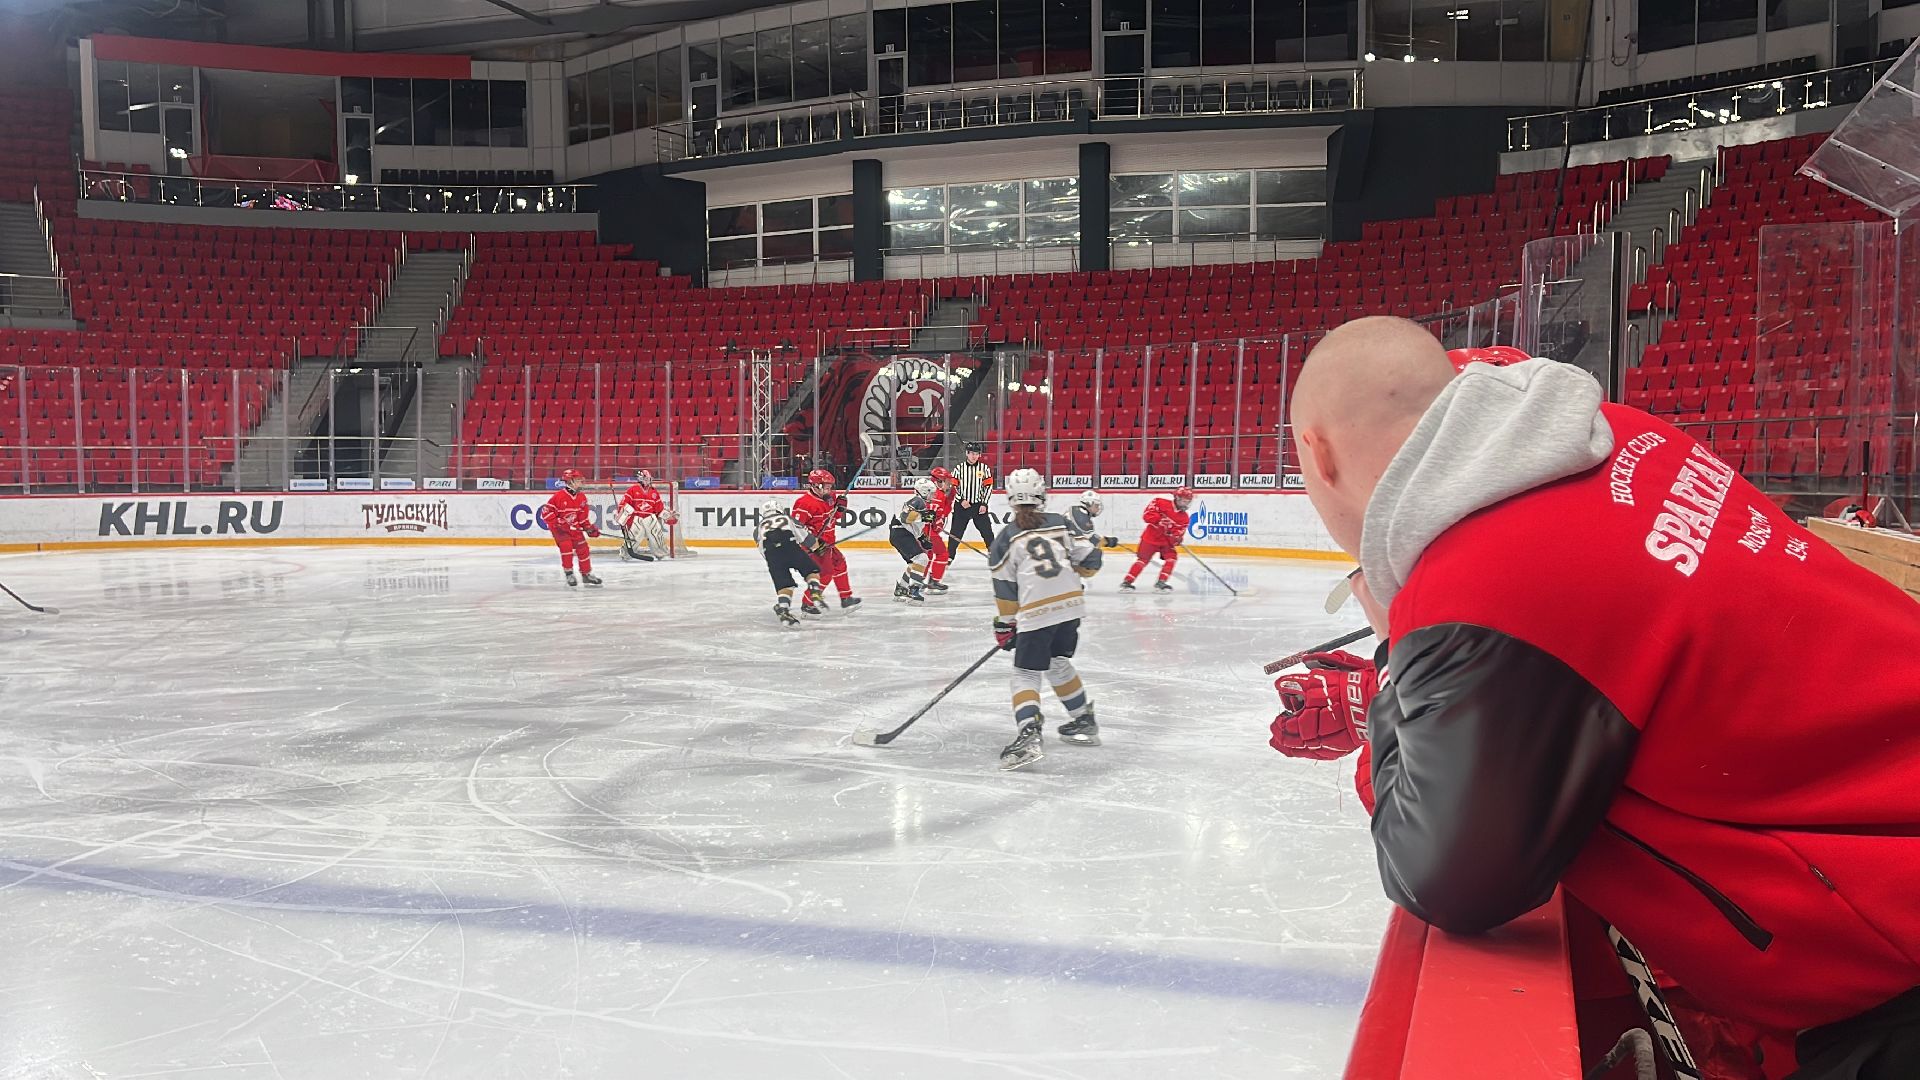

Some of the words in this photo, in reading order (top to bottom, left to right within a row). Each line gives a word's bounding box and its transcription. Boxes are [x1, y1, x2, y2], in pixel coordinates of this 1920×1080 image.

[1610, 448, 1640, 506] HOCKEY
[1628, 432, 1666, 454] CLUB
[857, 478, 889, 486] KHL.RU
[1056, 477, 1089, 485] KHL.RU
[1104, 477, 1136, 485] KHL.RU
[1150, 476, 1182, 485] KHL.RU
[1196, 476, 1229, 485] KHL.RU
[1242, 476, 1273, 485] KHL.RU
[1285, 476, 1304, 485] KHL.
[99, 501, 283, 536] KHL.RU
[362, 499, 448, 531] ТУЛЬСКИЙ
[1208, 512, 1248, 525] ГАЗПРОМ
